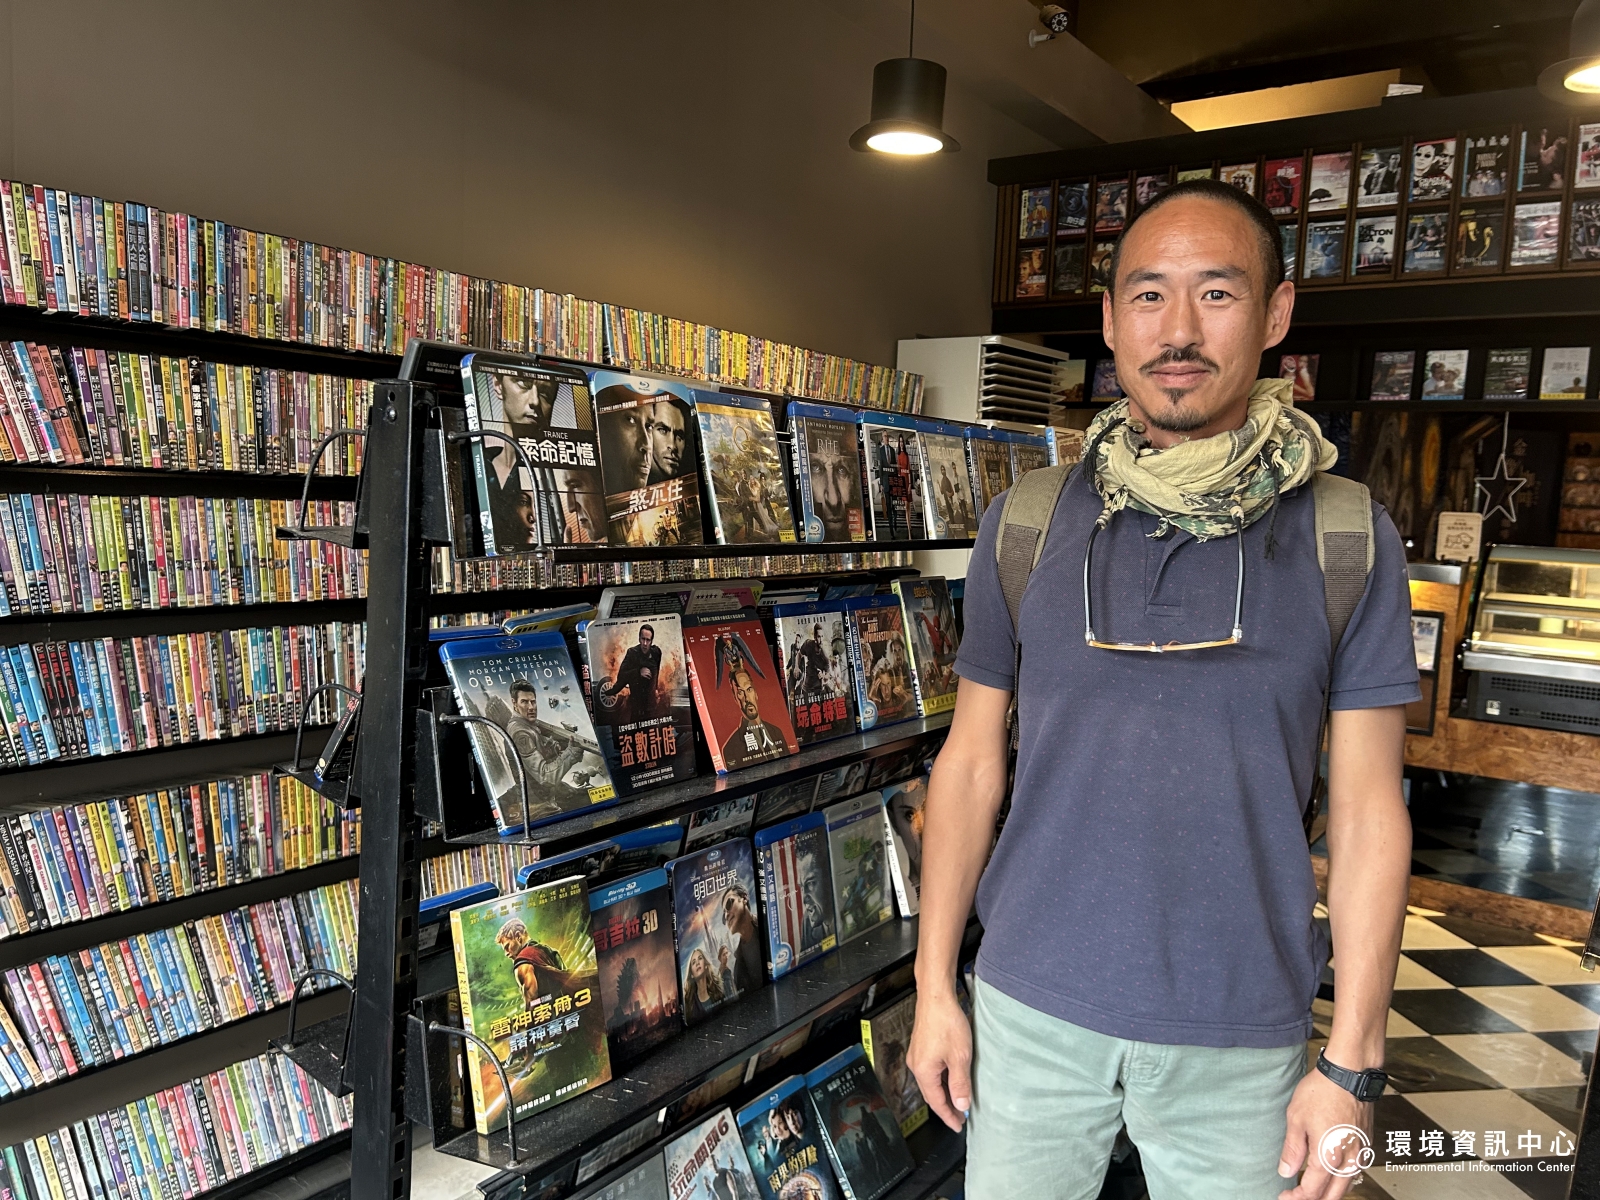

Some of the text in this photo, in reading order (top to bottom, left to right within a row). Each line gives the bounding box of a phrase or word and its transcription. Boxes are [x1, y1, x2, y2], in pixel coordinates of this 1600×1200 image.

[543, 430, 569, 440] TRANCE
[518, 437, 597, 467] 索命記憶
[629, 479, 684, 513] 煞不住
[76, 656, 85, 684] 1408
[468, 660, 559, 675] MORGAN FREEMAN
[508, 654, 543, 664] CRUISE
[468, 667, 567, 688] OBLIVION
[796, 697, 847, 728] 玩命特區
[618, 725, 677, 767] 盜數計時
[743, 728, 774, 752] 鳥人
[6, 845, 20, 876] ASSASSIN
[693, 868, 738, 901] 明日世界
[593, 908, 659, 953] 哥吉拉 3D
[490, 988, 592, 1039] 雷神索爾3
[508, 1013, 581, 1053] 諸神黃昏
[670, 1114, 730, 1198] 玩命關頭6
[766, 1143, 819, 1194] 雨果的冒險
